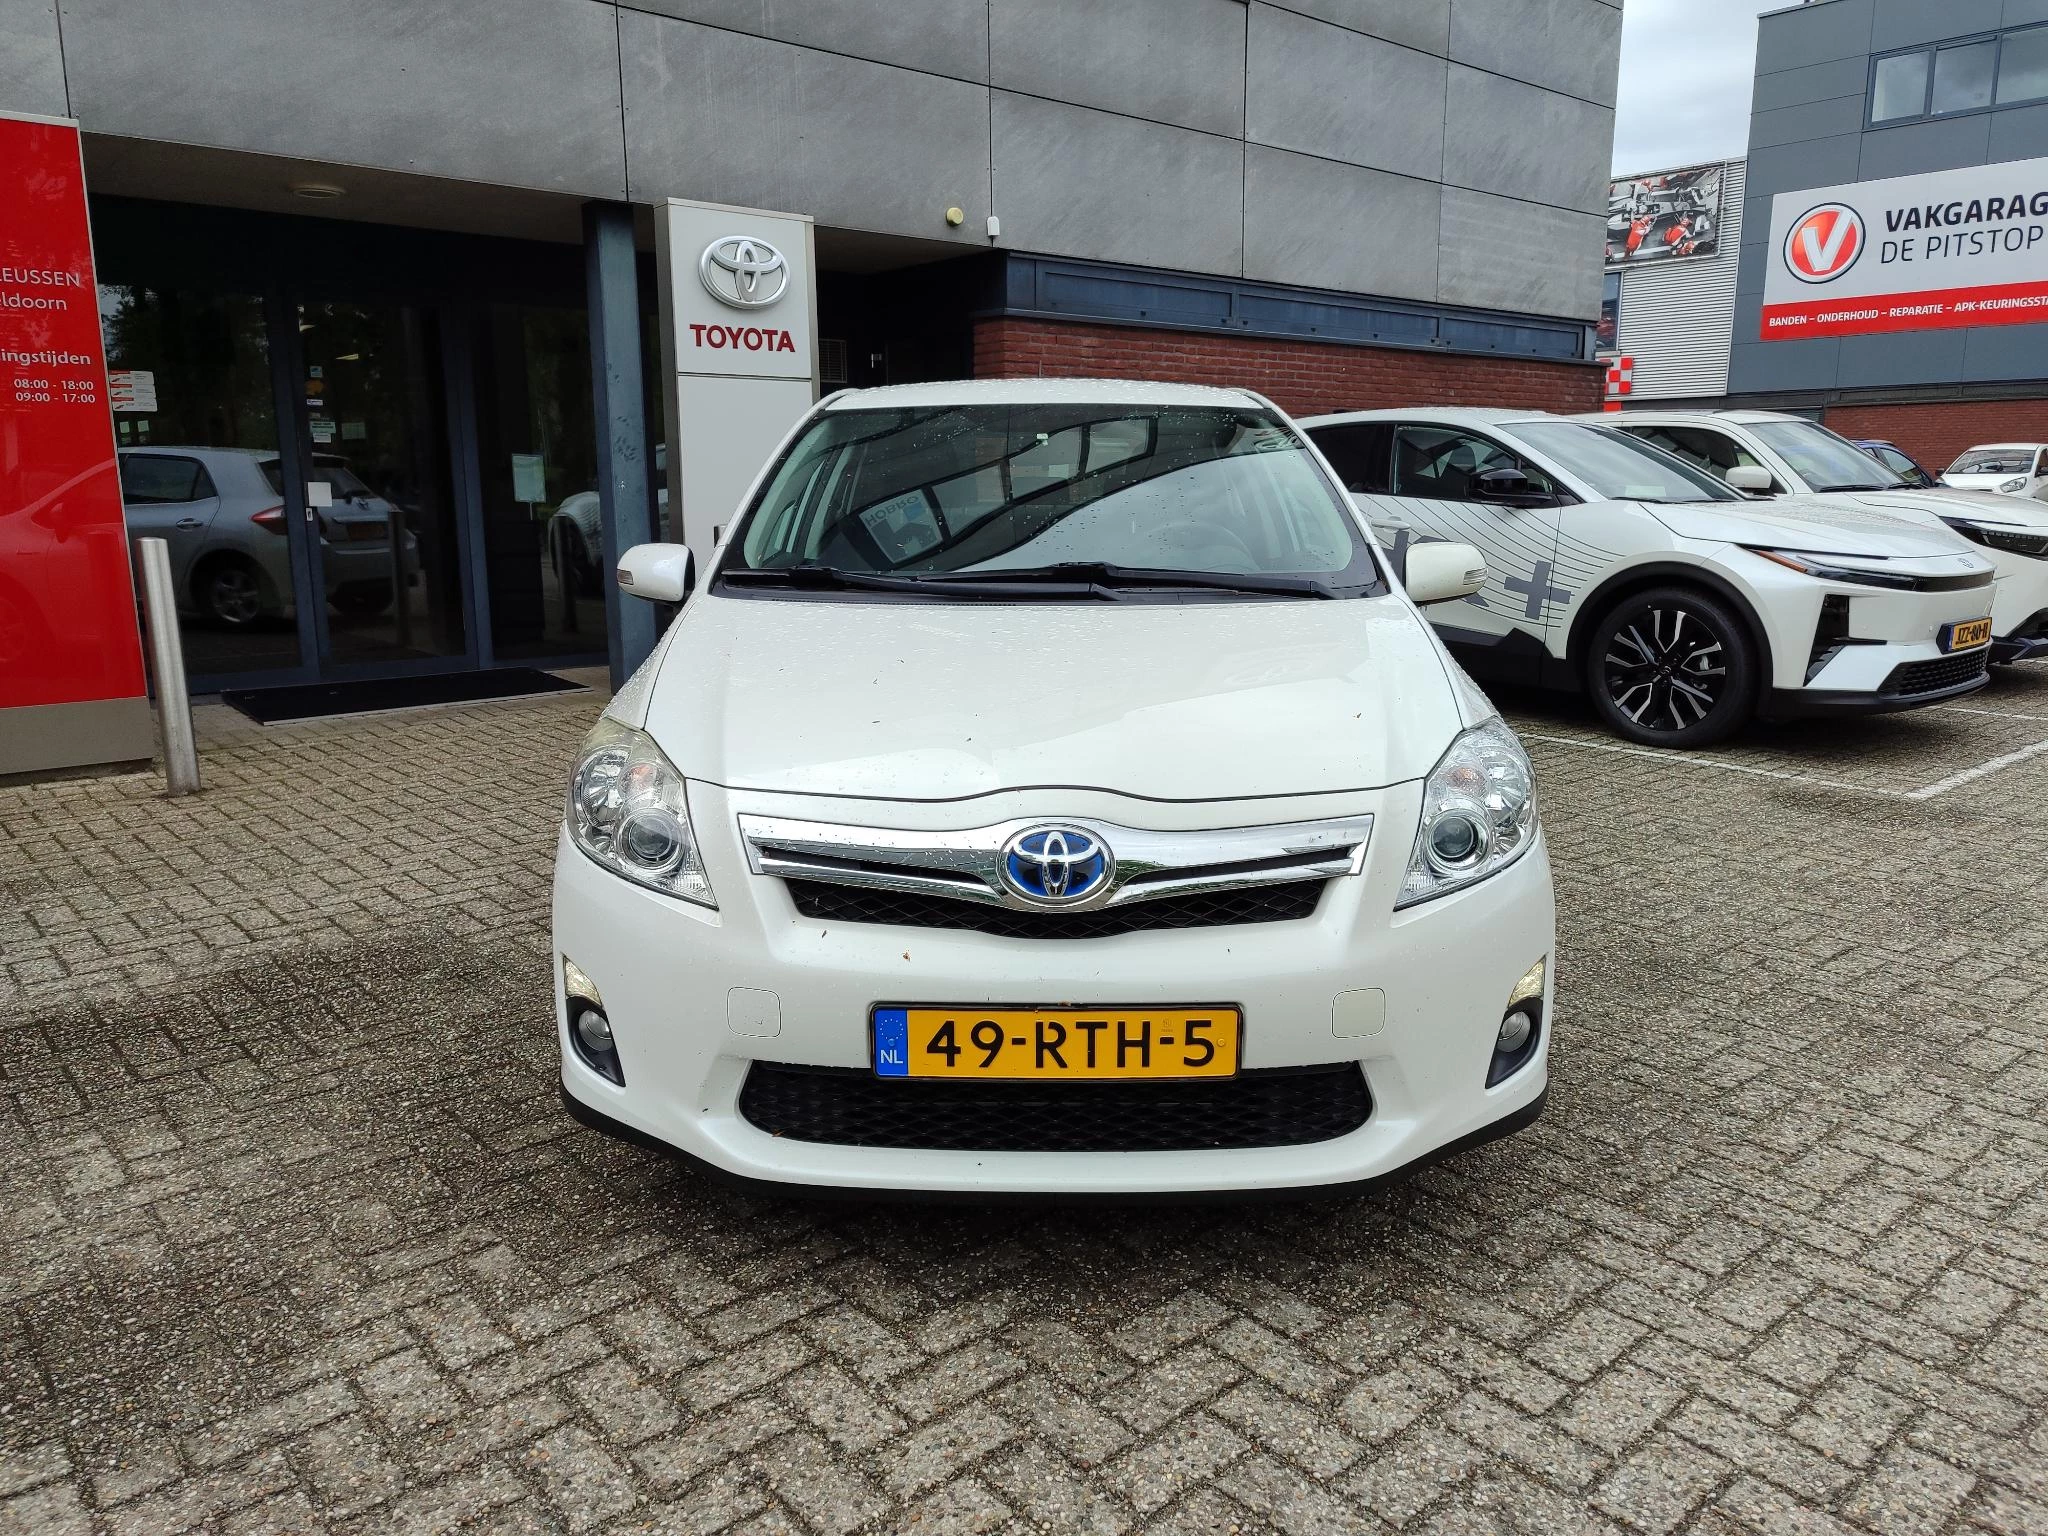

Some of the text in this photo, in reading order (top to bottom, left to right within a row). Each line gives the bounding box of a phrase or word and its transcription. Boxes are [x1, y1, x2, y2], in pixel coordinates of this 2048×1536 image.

[1886, 191, 2048, 233] VAKGARAG
[1881, 225, 2044, 264] DE PITSTOP
[0, 267, 80, 287] EUSSEN
[0, 292, 67, 311] ldoorn
[1769, 315, 1807, 327] BANDEN
[1817, 309, 1879, 322] ONDERHOUD
[1889, 304, 1943, 317] REPARATIE
[689, 324, 796, 353] TOYOTA
[1, 349, 91, 366] ingstijden
[14, 378, 48, 389] 08:00
[61, 380, 94, 391] 18:00
[16, 392, 50, 403] 09:00
[63, 394, 96, 403] 17:00
[926, 1020, 1215, 1069] 49-RTH-5
[881, 1050, 904, 1064] NL
